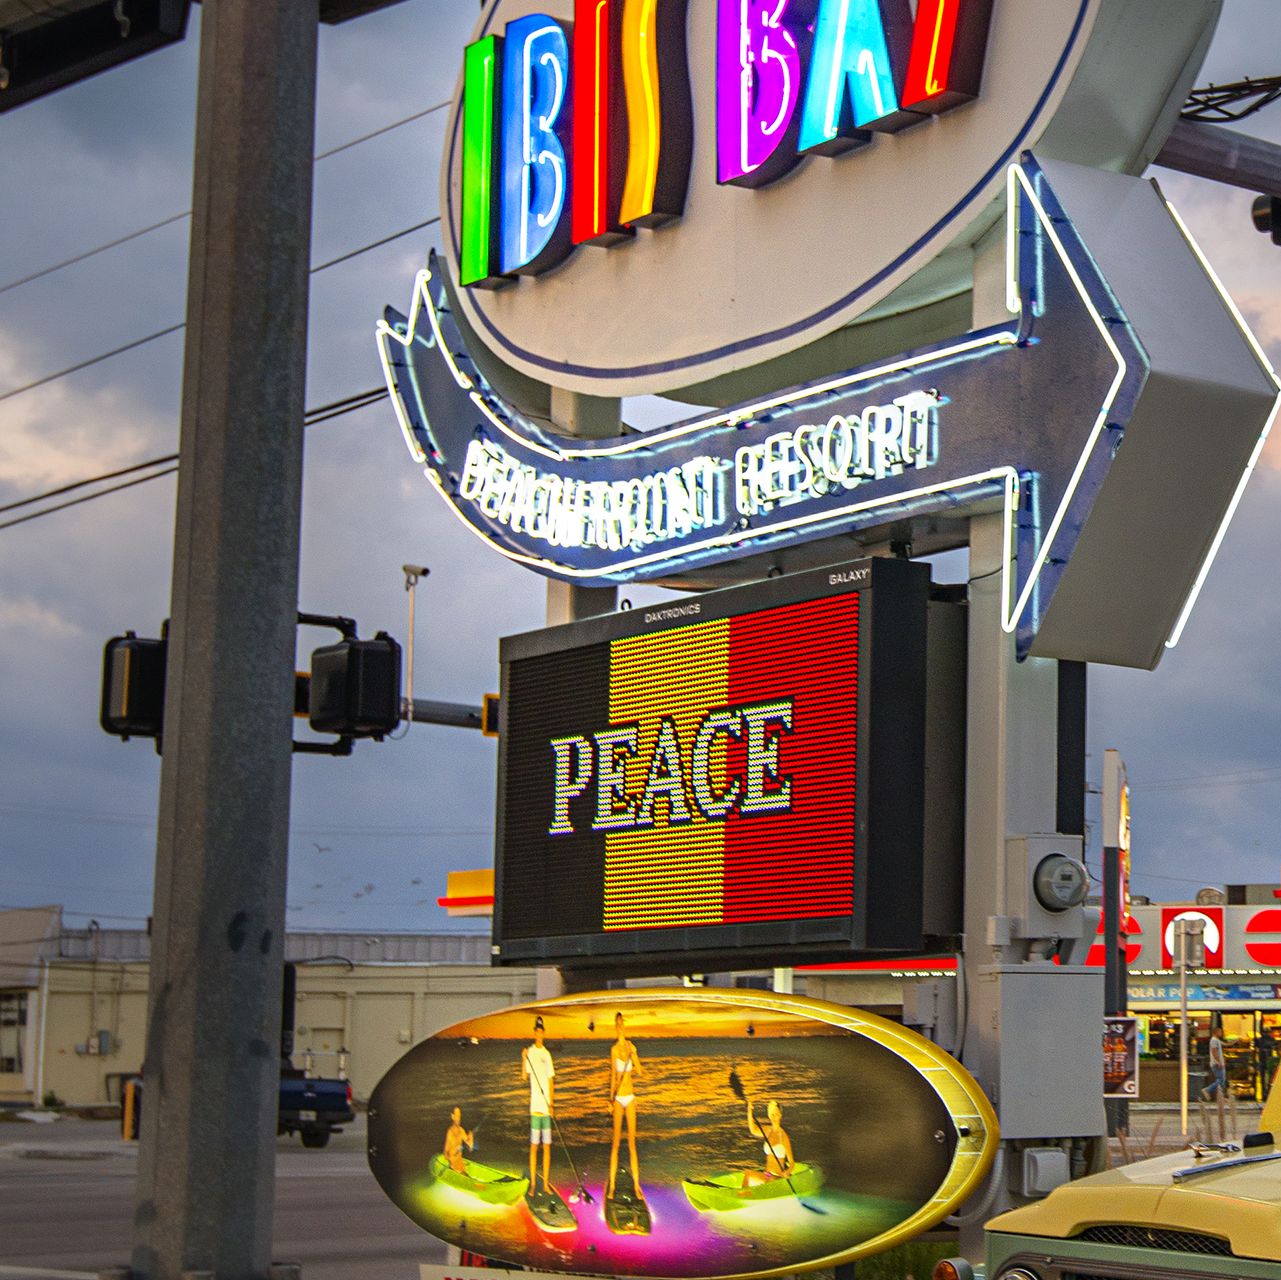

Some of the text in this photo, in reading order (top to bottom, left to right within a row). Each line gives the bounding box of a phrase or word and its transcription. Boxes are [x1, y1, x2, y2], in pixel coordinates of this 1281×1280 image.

[460, 390, 938, 551] BEACHFRONT RESORT
[829, 569, 868, 585] GALAXY
[644, 603, 701, 623] DAKTRONICS
[549, 702, 793, 835] PEACE
[1170, 988, 1193, 998] PP
